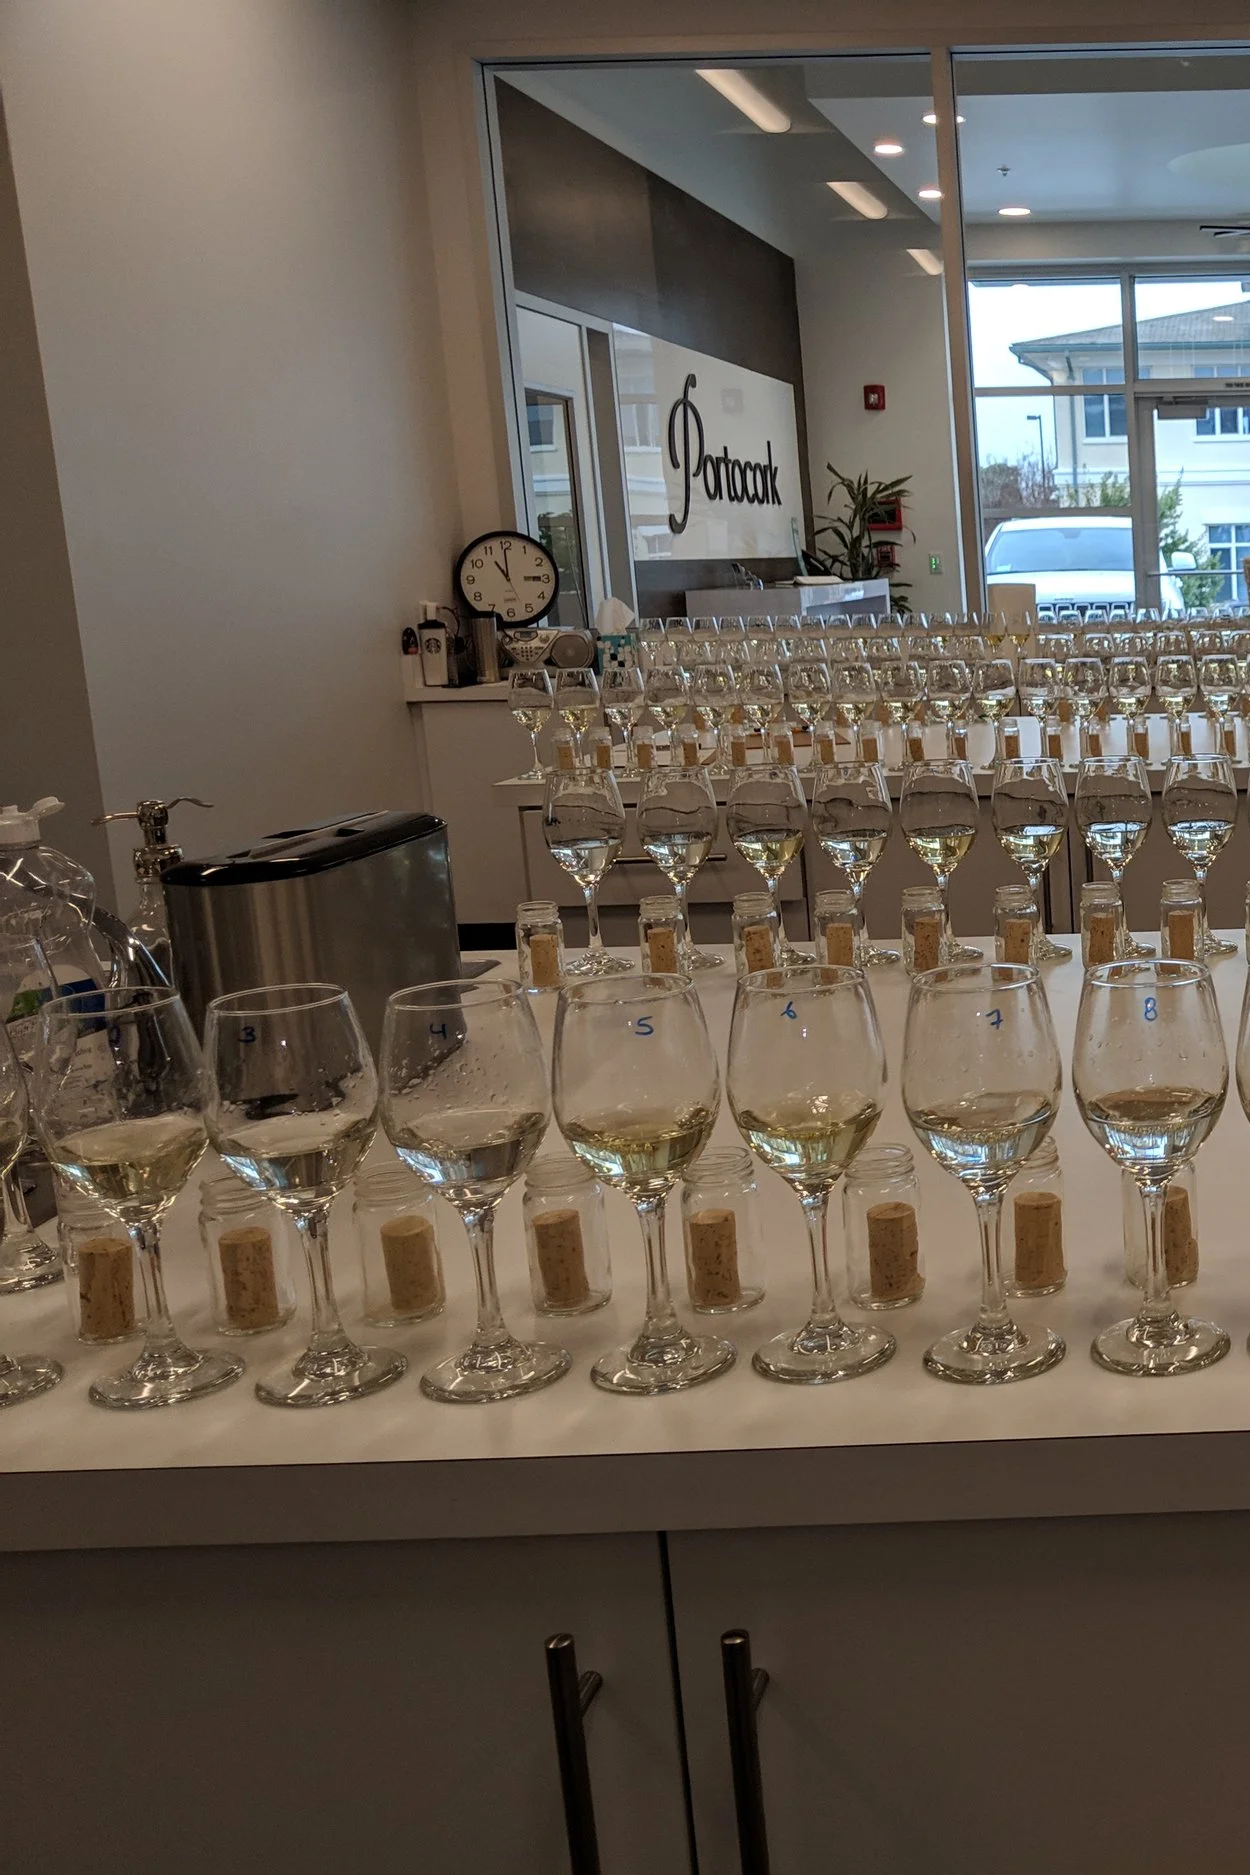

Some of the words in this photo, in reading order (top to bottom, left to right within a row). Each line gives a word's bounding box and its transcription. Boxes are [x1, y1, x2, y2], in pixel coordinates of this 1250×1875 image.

[668, 373, 782, 534] Portocork
[484, 546, 493, 555] 11
[500, 541, 512, 551] 12
[522, 545, 528, 555] 1
[470, 558, 484, 569] 10
[535, 557, 544, 567] 2
[466, 575, 475, 585] 9
[542, 574, 551, 584] 3
[474, 592, 483, 602] 8
[537, 591, 546, 600] 4
[488, 604, 496, 612] 7
[507, 608, 516, 618] 6
[525, 604, 534, 613] 5
[781, 1001, 799, 1021] 6
[1143, 997, 1158, 1021] 8
[985, 1009, 1004, 1031] 7
[429, 1023, 449, 1039] 4
[635, 1017, 655, 1038] 5
[238, 1027, 258, 1045] 3
